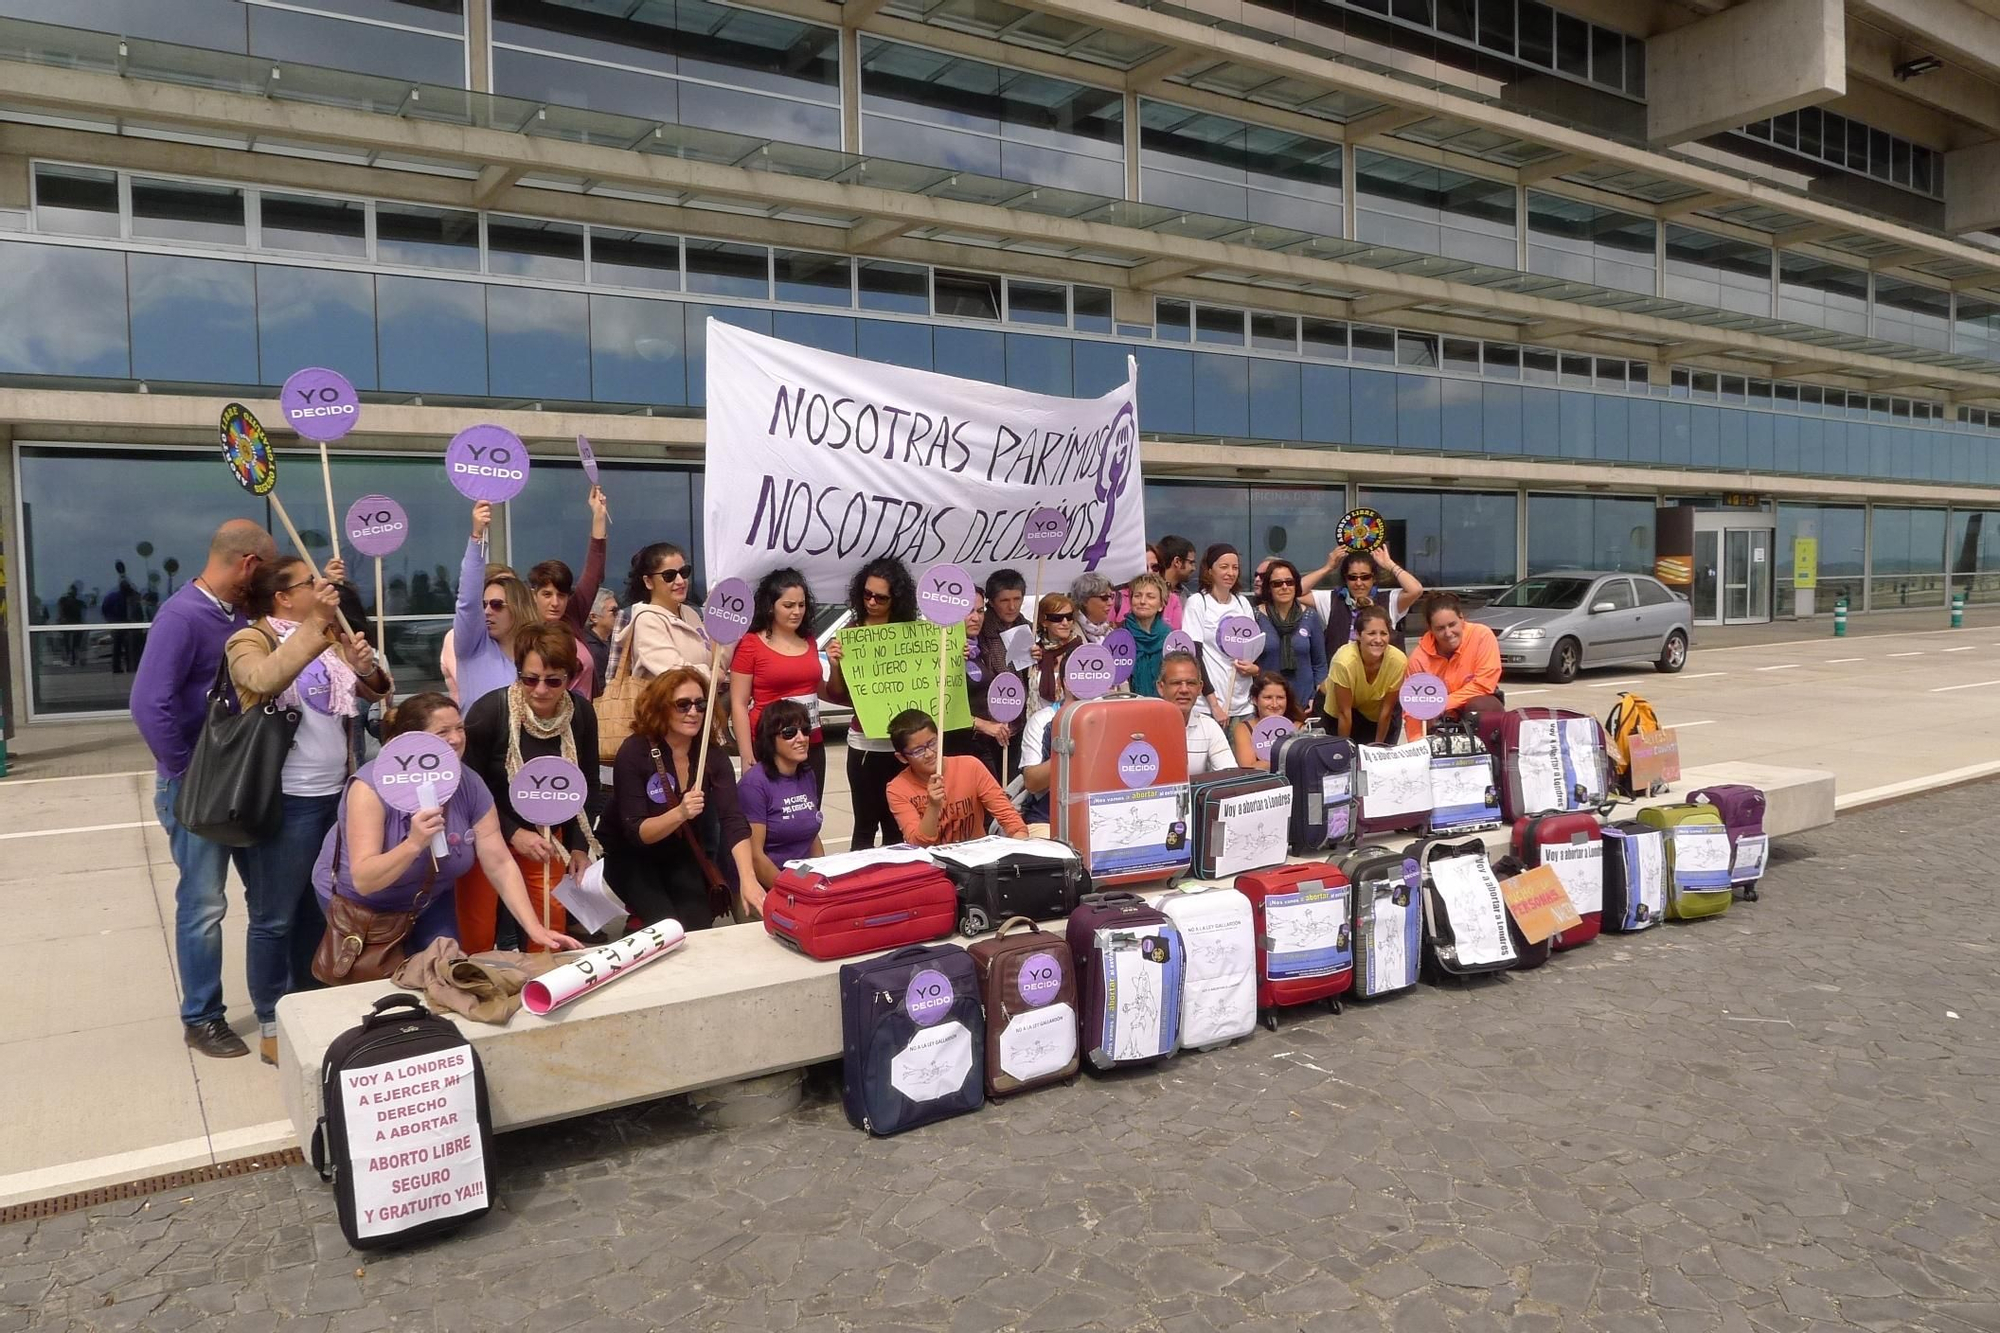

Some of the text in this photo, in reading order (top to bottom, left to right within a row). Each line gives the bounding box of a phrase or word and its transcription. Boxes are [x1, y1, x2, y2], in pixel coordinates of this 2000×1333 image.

[297, 387, 339, 404] YO
[222, 406, 239, 431] LIBRE
[291, 404, 355, 419] DECIDO
[243, 412, 274, 461] GRATUITO
[769, 385, 1109, 486] NOSOTRAS PARIMOS
[222, 433, 247, 486] ABORTO
[467, 444, 511, 464] YO
[454, 462, 523, 480] DECIDO
[254, 471, 275, 493] SEGURO
[358, 511, 391, 526] YO
[746, 475, 956, 563] NOSOTRAS
[1035, 520, 1057, 531] YO
[352, 522, 403, 538] DECIDO
[1027, 531, 1064, 540] DECIDO
[1336, 515, 1351, 543] ABORTO
[933, 578, 963, 595] YO
[720, 593, 744, 612] YO
[922, 592, 969, 607] DECIDO
[708, 606, 748, 625] DECIDO
[841, 627, 897, 645] HAGAMOS
[902, 624, 917, 639] UN
[1232, 626, 1252, 637] YO
[852, 638, 958, 660] TÚ NO LEGISLAS EN
[1108, 644, 1128, 656] YO
[852, 666, 865, 679] MI
[872, 660, 907, 677] ÚTERO
[915, 658, 922, 671] Y
[950, 655, 962, 668] NO
[1078, 659, 1104, 671] YO
[1114, 658, 1133, 666] CIDO
[1070, 672, 1111, 680] DECIDO
[853, 684, 868, 696] TE
[872, 681, 904, 694] CORTO
[911, 676, 930, 690] LOS
[997, 687, 1017, 698] YO
[1411, 685, 1437, 695] YO
[990, 697, 1022, 706] DECIDO
[1404, 696, 1444, 704] DECIDO
[1262, 727, 1287, 740] YO
[394, 753, 440, 771] YO
[1129, 754, 1150, 764] YO
[1121, 764, 1156, 772] DECIDO
[382, 770, 454, 785] DECIDO
[530, 775, 570, 790] YO
[517, 791, 581, 801] DECIDO
[1131, 791, 1158, 799] abortar
[1224, 792, 1291, 818] Voy a abortar a Londres
[1545, 848, 1559, 862] Voy
[1406, 864, 1417, 873] YO
[1305, 892, 1329, 901] abortar
[1485, 882, 1500, 913] abortar
[1497, 921, 1509, 956] Londres
[1029, 967, 1053, 980] YO
[917, 984, 941, 999] YO
[1023, 979, 1059, 991] DECIDO
[1108, 979, 1116, 1011] abortar
[912, 996, 951, 1012] DECIDO
[349, 1054, 465, 1089] VOY A LONDRES
[359, 1095, 369, 1107] A
[373, 1080, 441, 1104] EJERCER
[377, 1097, 447, 1122] DERECHO
[375, 1112, 458, 1142] A ABORTAR
[369, 1135, 471, 1172] ABORTO LIBRE
[392, 1168, 451, 1194] SEGURO
[364, 1181, 484, 1224] Y GRATUITO YA!!!
